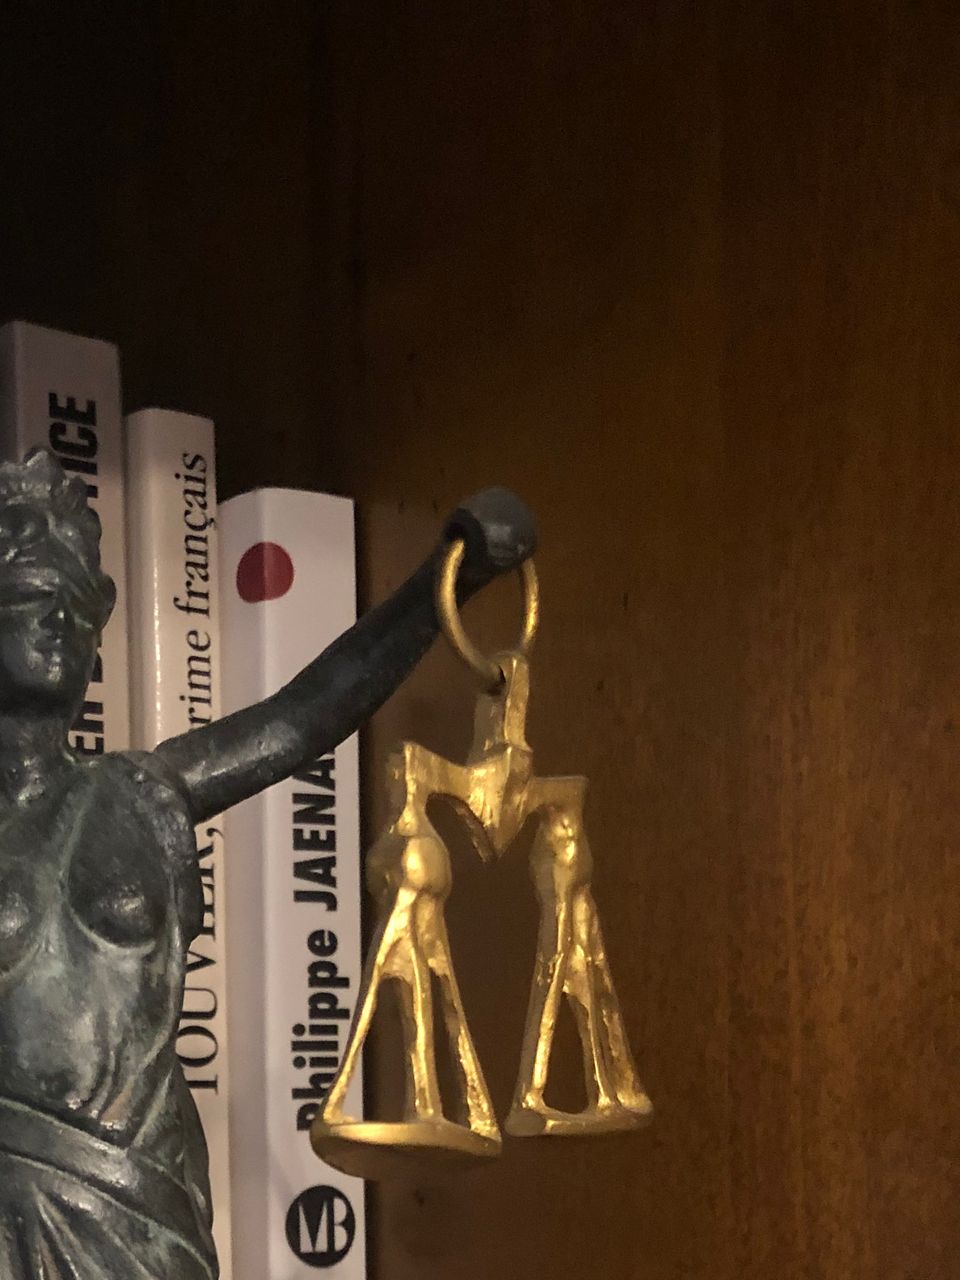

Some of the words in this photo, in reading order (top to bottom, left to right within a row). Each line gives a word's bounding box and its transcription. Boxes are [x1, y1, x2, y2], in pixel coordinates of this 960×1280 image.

[173, 452, 216, 619] français
[180, 630, 212, 727] rime
[292, 748, 339, 912] JAENA
